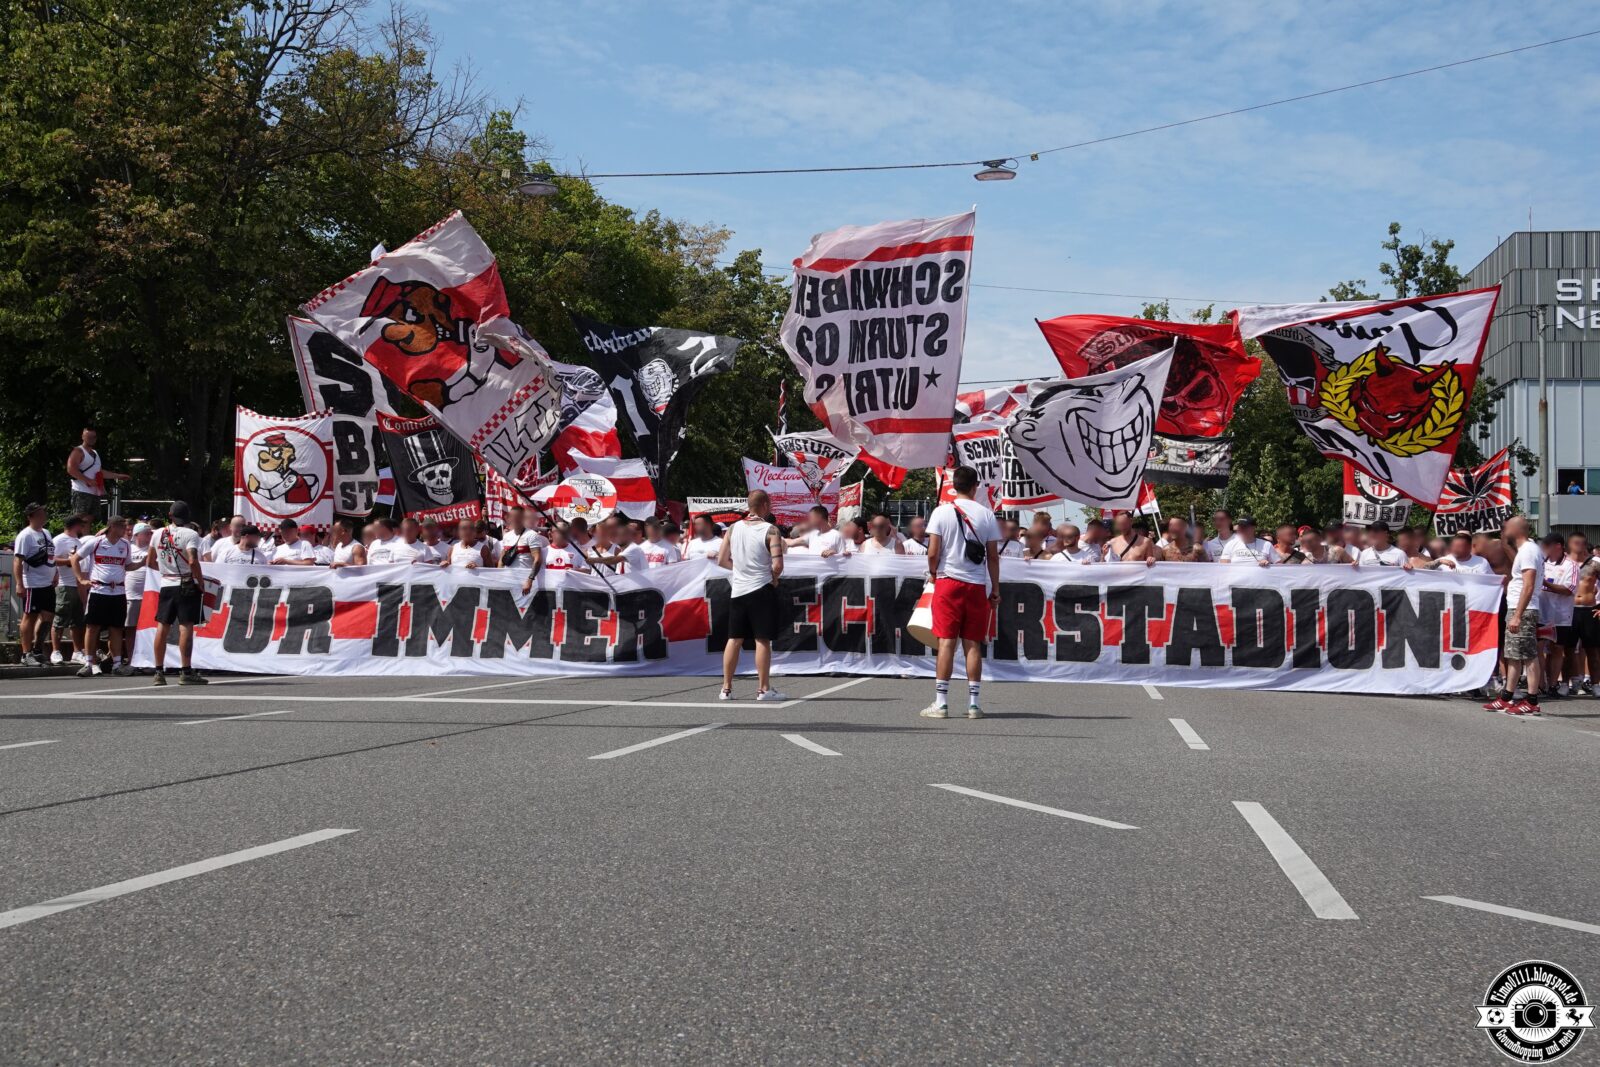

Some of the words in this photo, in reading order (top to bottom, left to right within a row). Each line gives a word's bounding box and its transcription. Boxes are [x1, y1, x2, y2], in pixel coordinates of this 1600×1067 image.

[383, 417, 440, 431] Comman
[339, 481, 378, 510] ST
[168, 575, 335, 656] ÜR
[372, 580, 669, 664] IMMER
